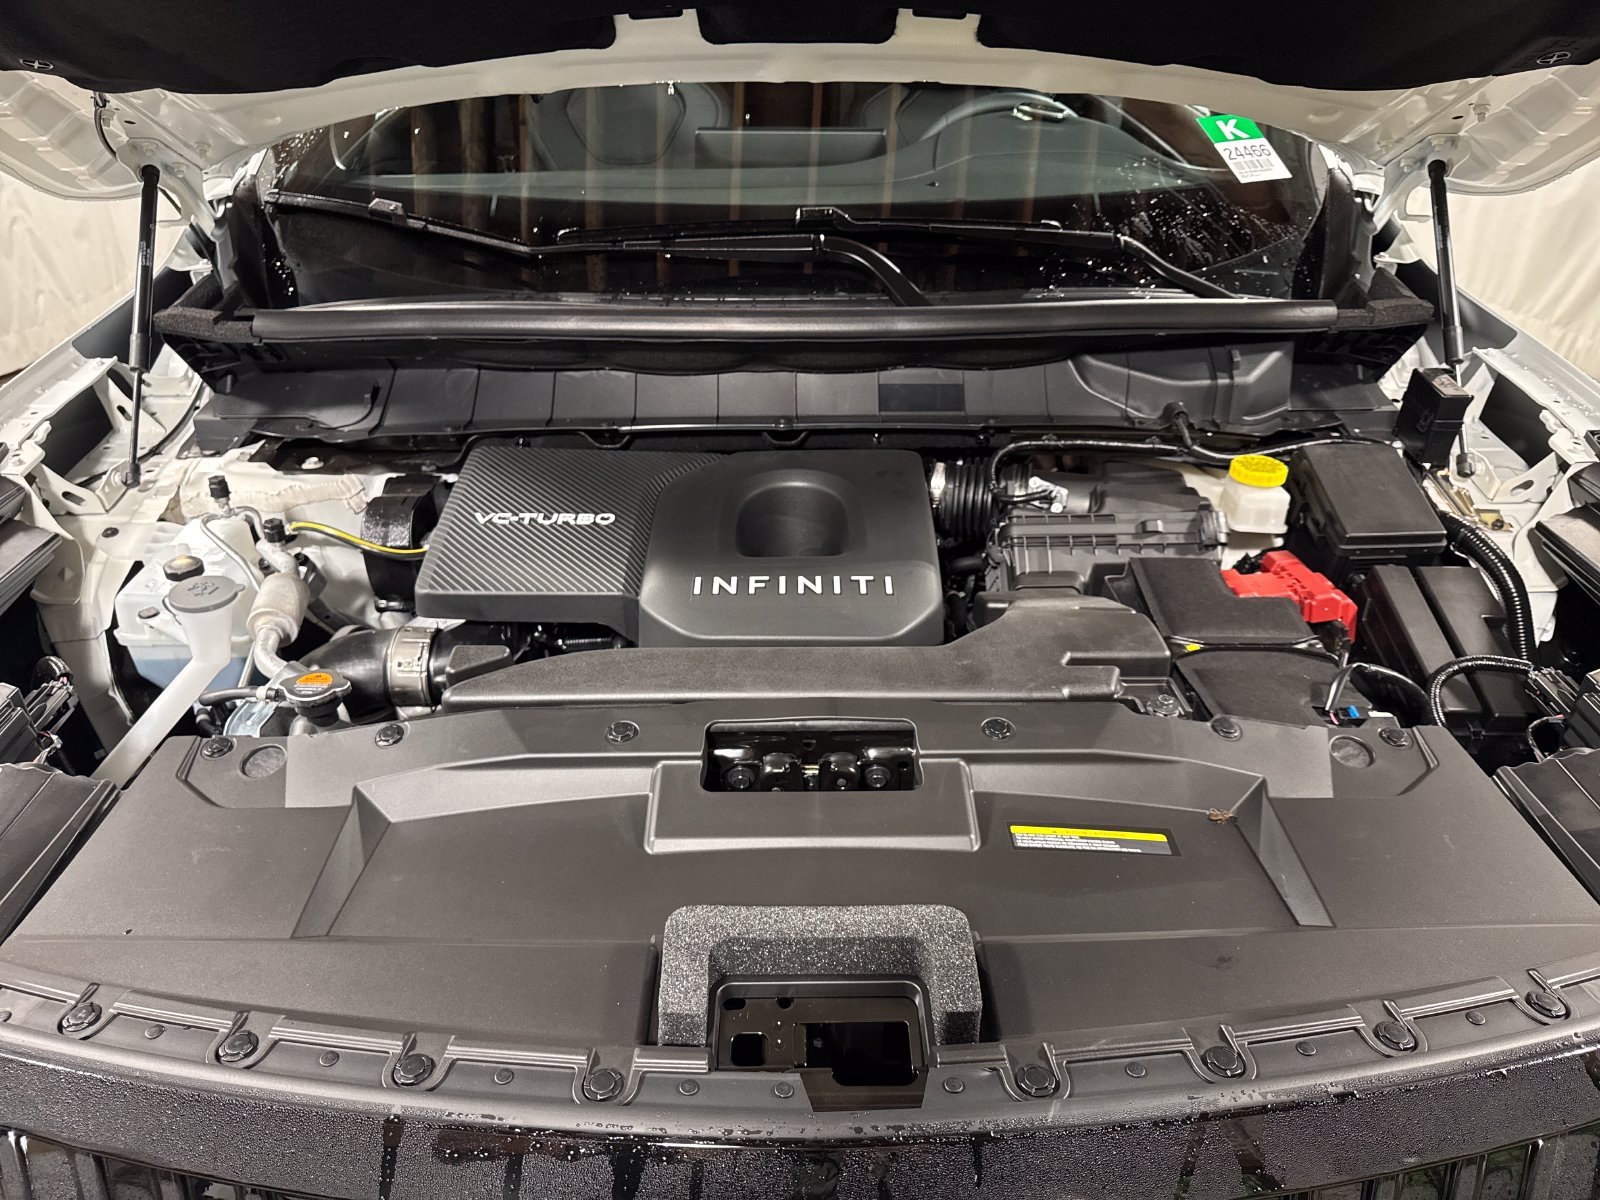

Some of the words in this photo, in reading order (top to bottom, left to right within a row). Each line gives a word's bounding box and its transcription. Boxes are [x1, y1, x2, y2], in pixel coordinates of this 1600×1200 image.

[1216, 119, 1250, 140] K
[1223, 144, 1271, 161] 24466
[474, 512, 616, 525] VC-TURBO
[693, 575, 894, 595] INFINITI
